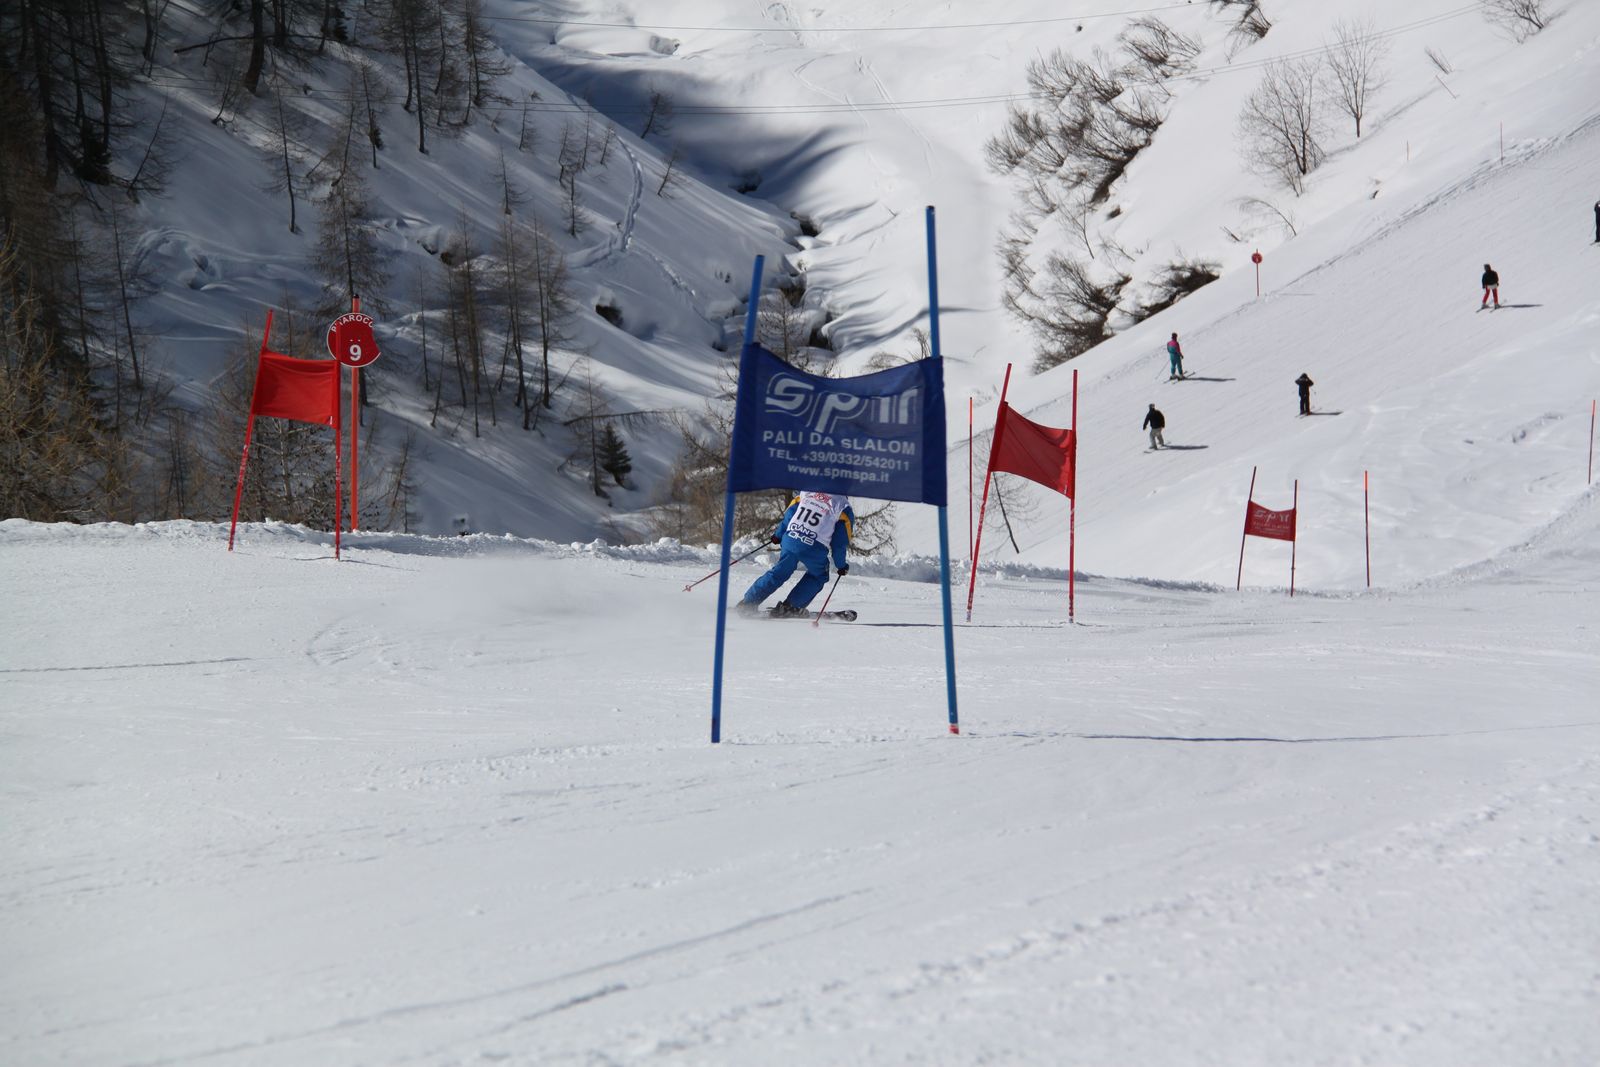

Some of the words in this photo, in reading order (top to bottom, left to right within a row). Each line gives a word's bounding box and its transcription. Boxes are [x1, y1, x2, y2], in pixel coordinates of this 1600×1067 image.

[349, 344, 362, 361] 9
[763, 430, 803, 445] PALI
[810, 433, 835, 446] DA
[841, 438, 916, 455] SLALOM
[768, 447, 798, 461] TEL.
[801, 451, 910, 471] +39/0332/542011
[787, 463, 890, 483] www.spmspa.it
[796, 506, 823, 527] 115
